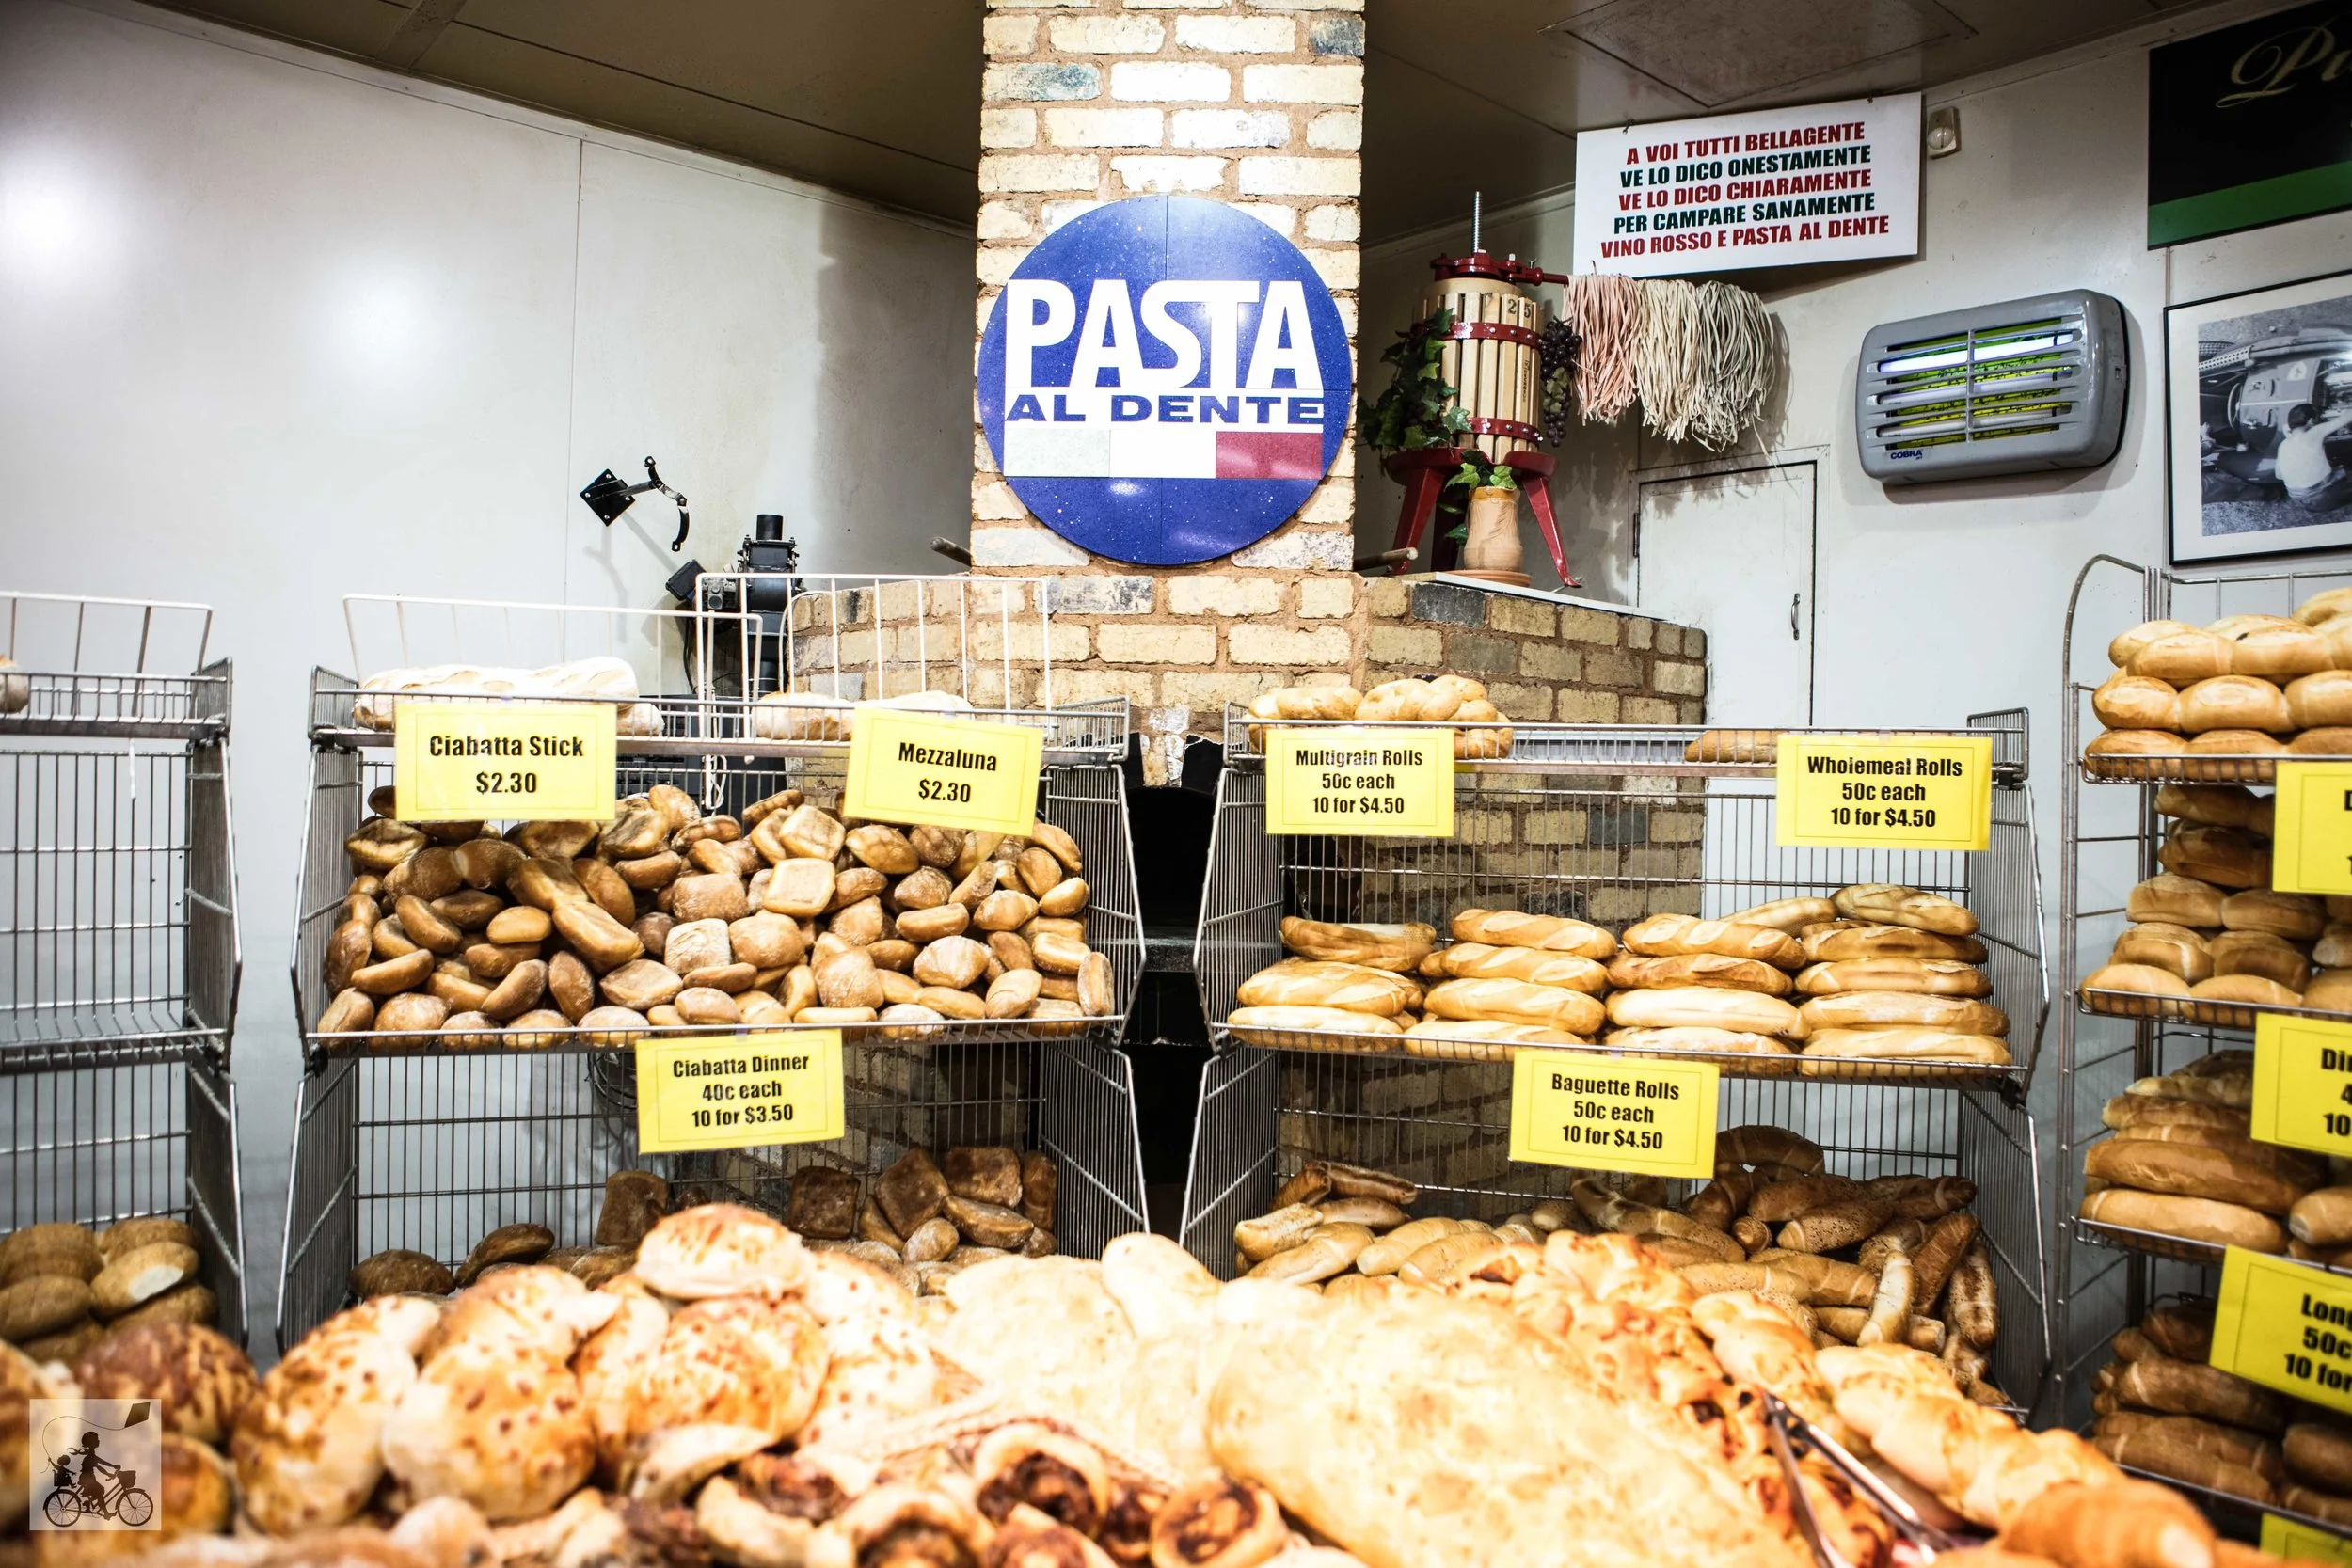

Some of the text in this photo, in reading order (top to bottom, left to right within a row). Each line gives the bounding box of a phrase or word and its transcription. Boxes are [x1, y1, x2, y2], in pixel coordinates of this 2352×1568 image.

[1627, 121, 1865, 165] A VOI TUTTI BELLAGENTE
[1621, 145, 1871, 188] VE LO DICO ONESTAMENTE
[1618, 168, 1871, 211] VE LO DICO CHIARAMENTE
[1613, 192, 1875, 234] PER CAMPARE SANAMENTE
[1601, 215, 1889, 259] VINO ROSSO E PASTA AL DENTE
[1005, 279, 1324, 388] PASTA
[1006, 394, 1324, 424] AL DENTE
[1890, 449, 1923, 460] COBRA
[430, 736, 583, 756] Ciabatta Stick
[898, 742, 997, 771] Mezzaluna
[1296, 750, 1422, 767] Multigrain Rolls
[1807, 757, 1962, 776] Wholemeal Rolls
[476, 771, 537, 794] $2.30
[918, 779, 971, 802] $2.30
[1322, 773, 1395, 789] 50c each
[1842, 783, 1926, 800] 50c each
[1312, 797, 1404, 814] 10 for $4.50
[1831, 808, 1935, 828] 10 for $4.50
[673, 1056, 809, 1077] Ciabatta Dinner
[703, 1081, 781, 1101] 40c each
[1552, 1073, 1679, 1100] Baguette Rolls
[692, 1104, 793, 1127] 10 for $3.50
[1574, 1101, 1654, 1123] 50c each
[2322, 1112, 2351, 1137] 10
[1563, 1125, 1662, 1148] 10 for $4.50
[2302, 1325, 2352, 1360] 50c
[2283, 1353, 2312, 1381] 10
